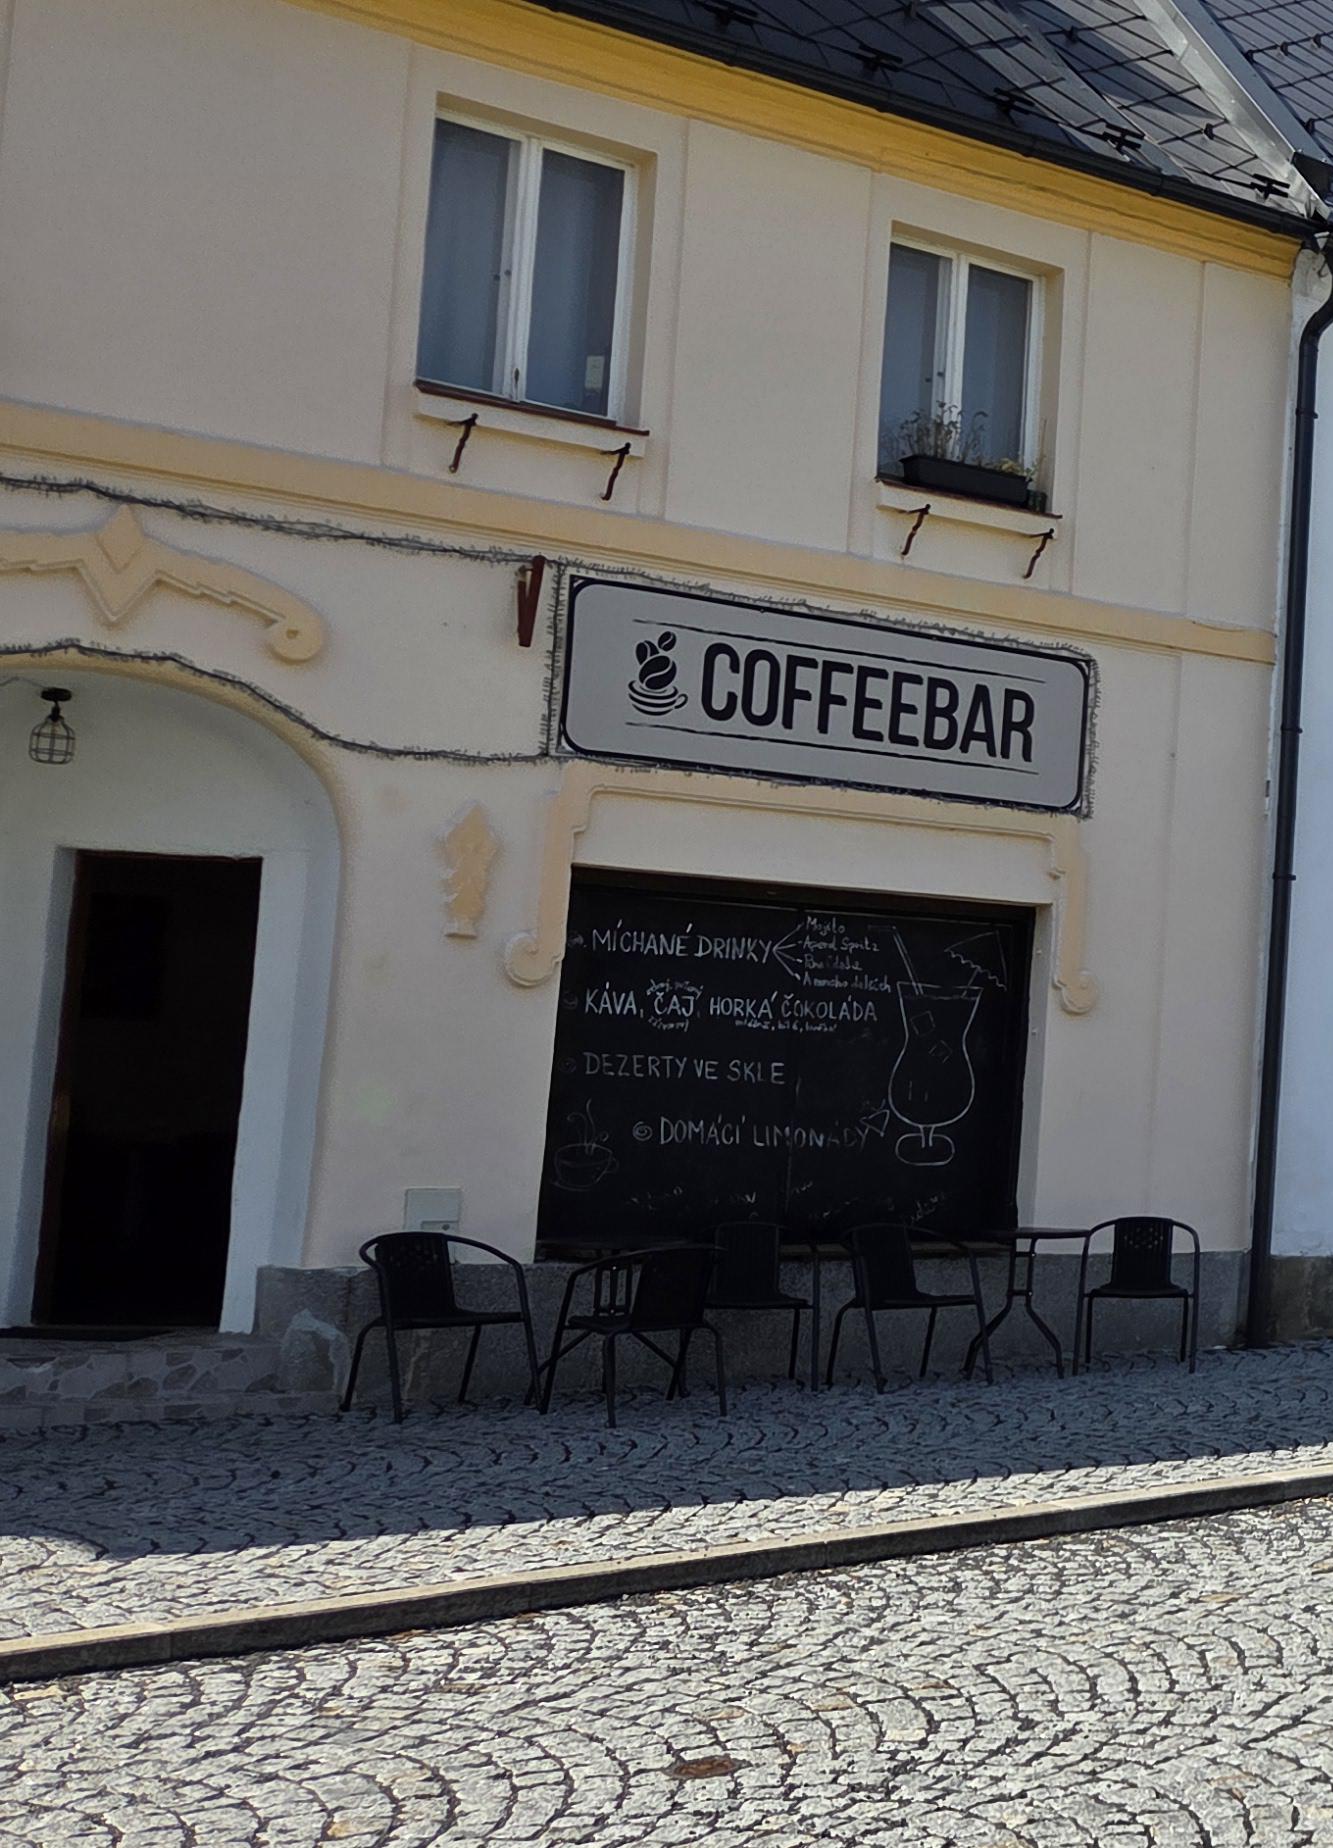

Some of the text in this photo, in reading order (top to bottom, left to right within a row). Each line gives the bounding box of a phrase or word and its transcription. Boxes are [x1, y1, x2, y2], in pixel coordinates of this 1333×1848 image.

[700, 642, 1036, 763] COFFEEBAR
[592, 919, 772, 964] MÍCHANÉ DRINKY
[709, 990, 778, 1019] HORKÁ
[781, 993, 878, 1022] ČOKOLÁDA
[583, 1051, 785, 1084] DEZERTY VE SKLE
[660, 1113, 747, 1146] DOMÁCÍ
